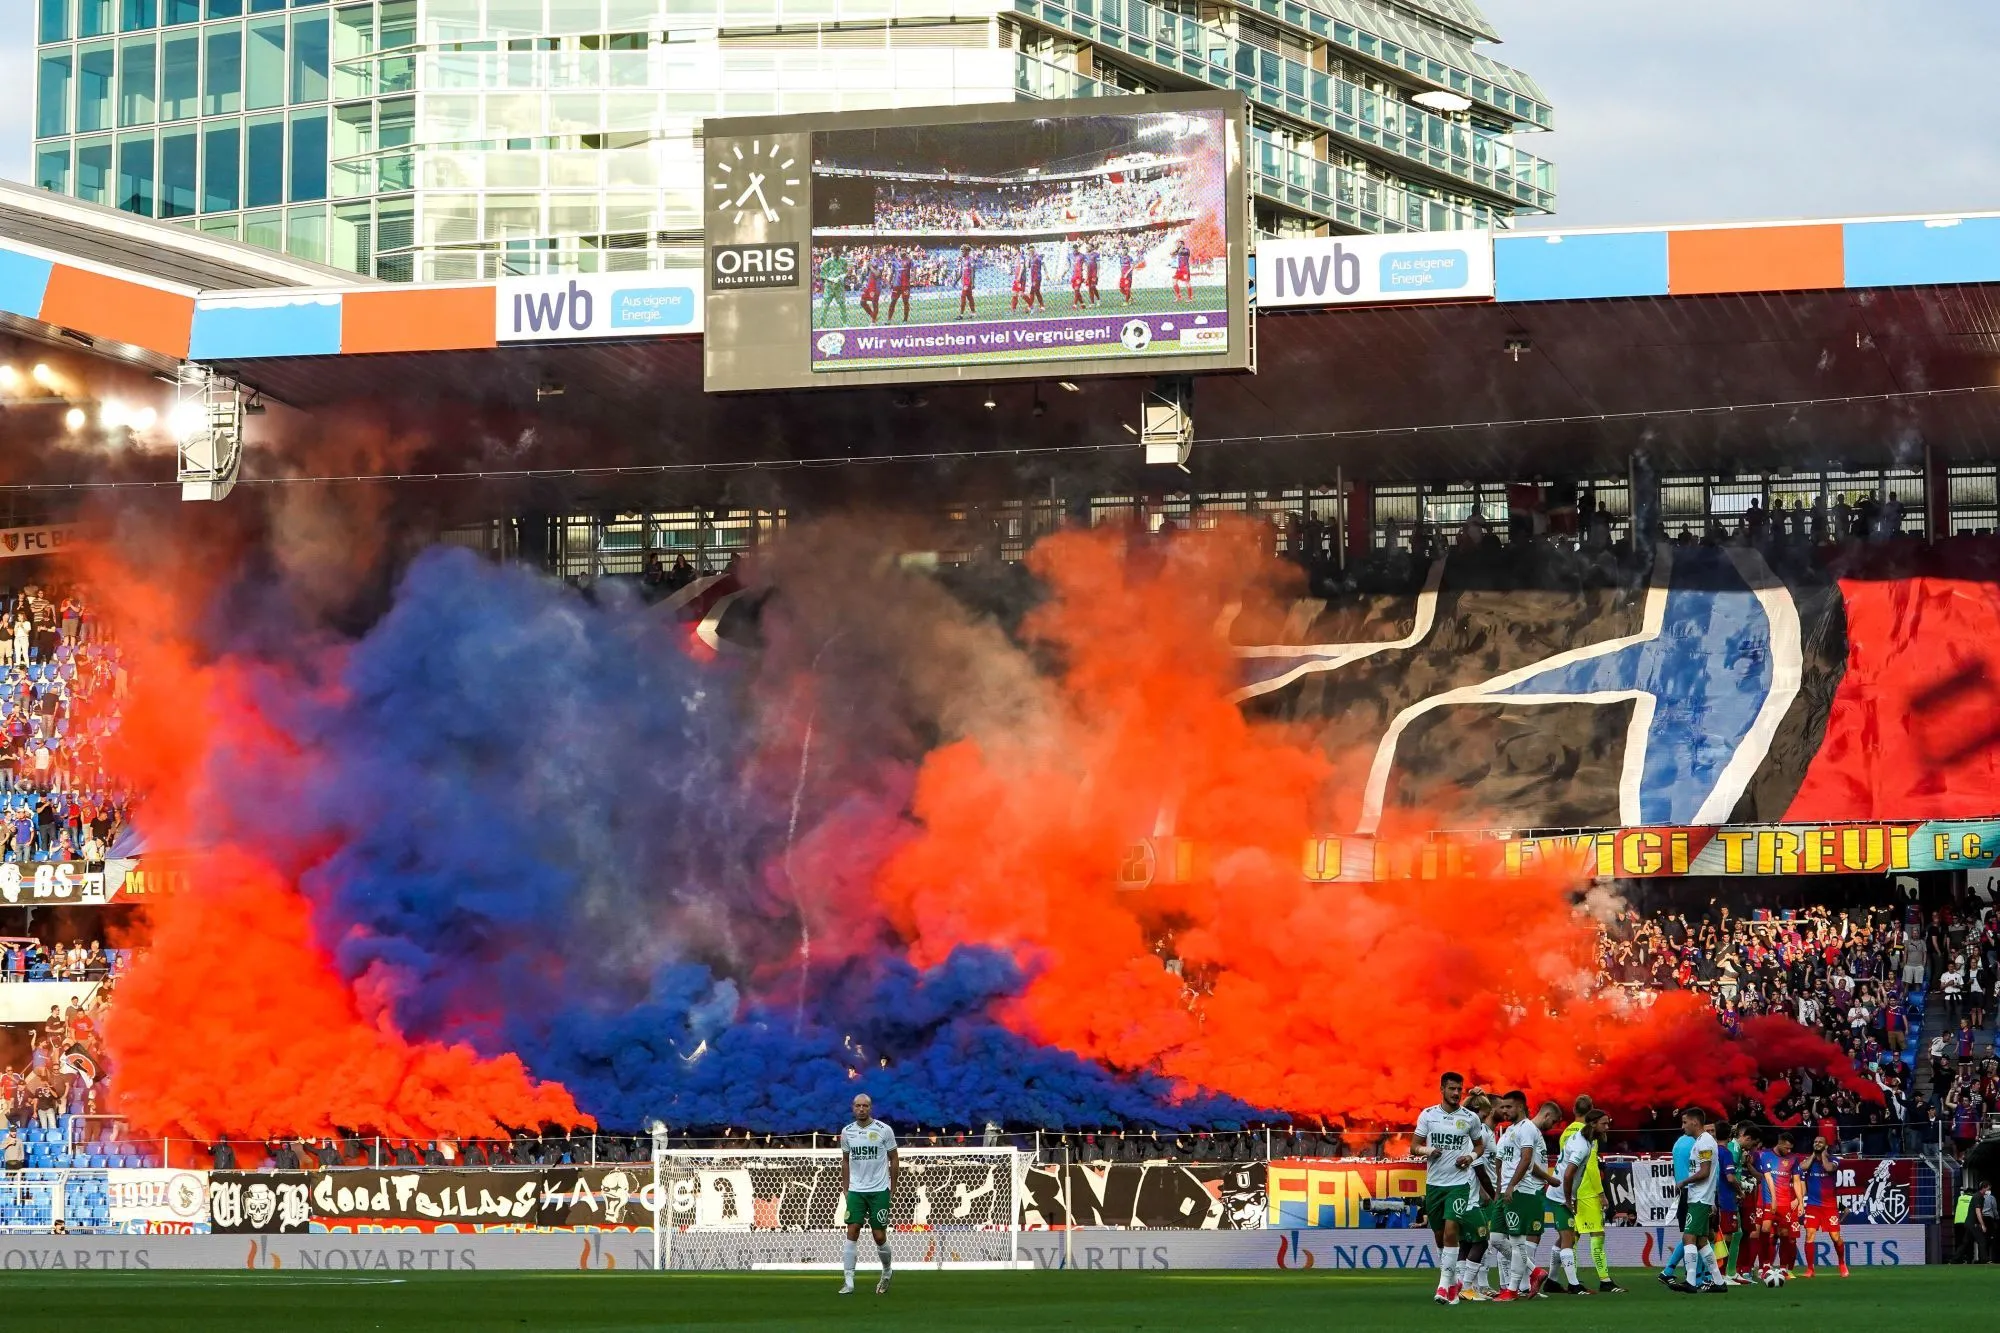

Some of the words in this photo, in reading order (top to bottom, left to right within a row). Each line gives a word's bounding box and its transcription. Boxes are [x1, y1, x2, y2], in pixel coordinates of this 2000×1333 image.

[716, 248, 795, 274] ORIS
[1391, 259, 1412, 270] Aus
[1414, 257, 1457, 271] eigener
[770, 274, 794, 282] 1904
[1391, 273, 1435, 287] Energie.
[622, 296, 641, 306] Aus
[643, 294, 682, 308] eigener
[621, 309, 663, 322] Energie.
[857, 337, 886, 350] Wir
[890, 333, 976, 349] wünschen
[980, 330, 1010, 344] viel
[1013, 325, 1111, 344] Vergnügen!
[24, 531, 48, 550] FC
[114, 1181, 166, 1208] 1997
[300, 1249, 476, 1270] NOVARTIS
